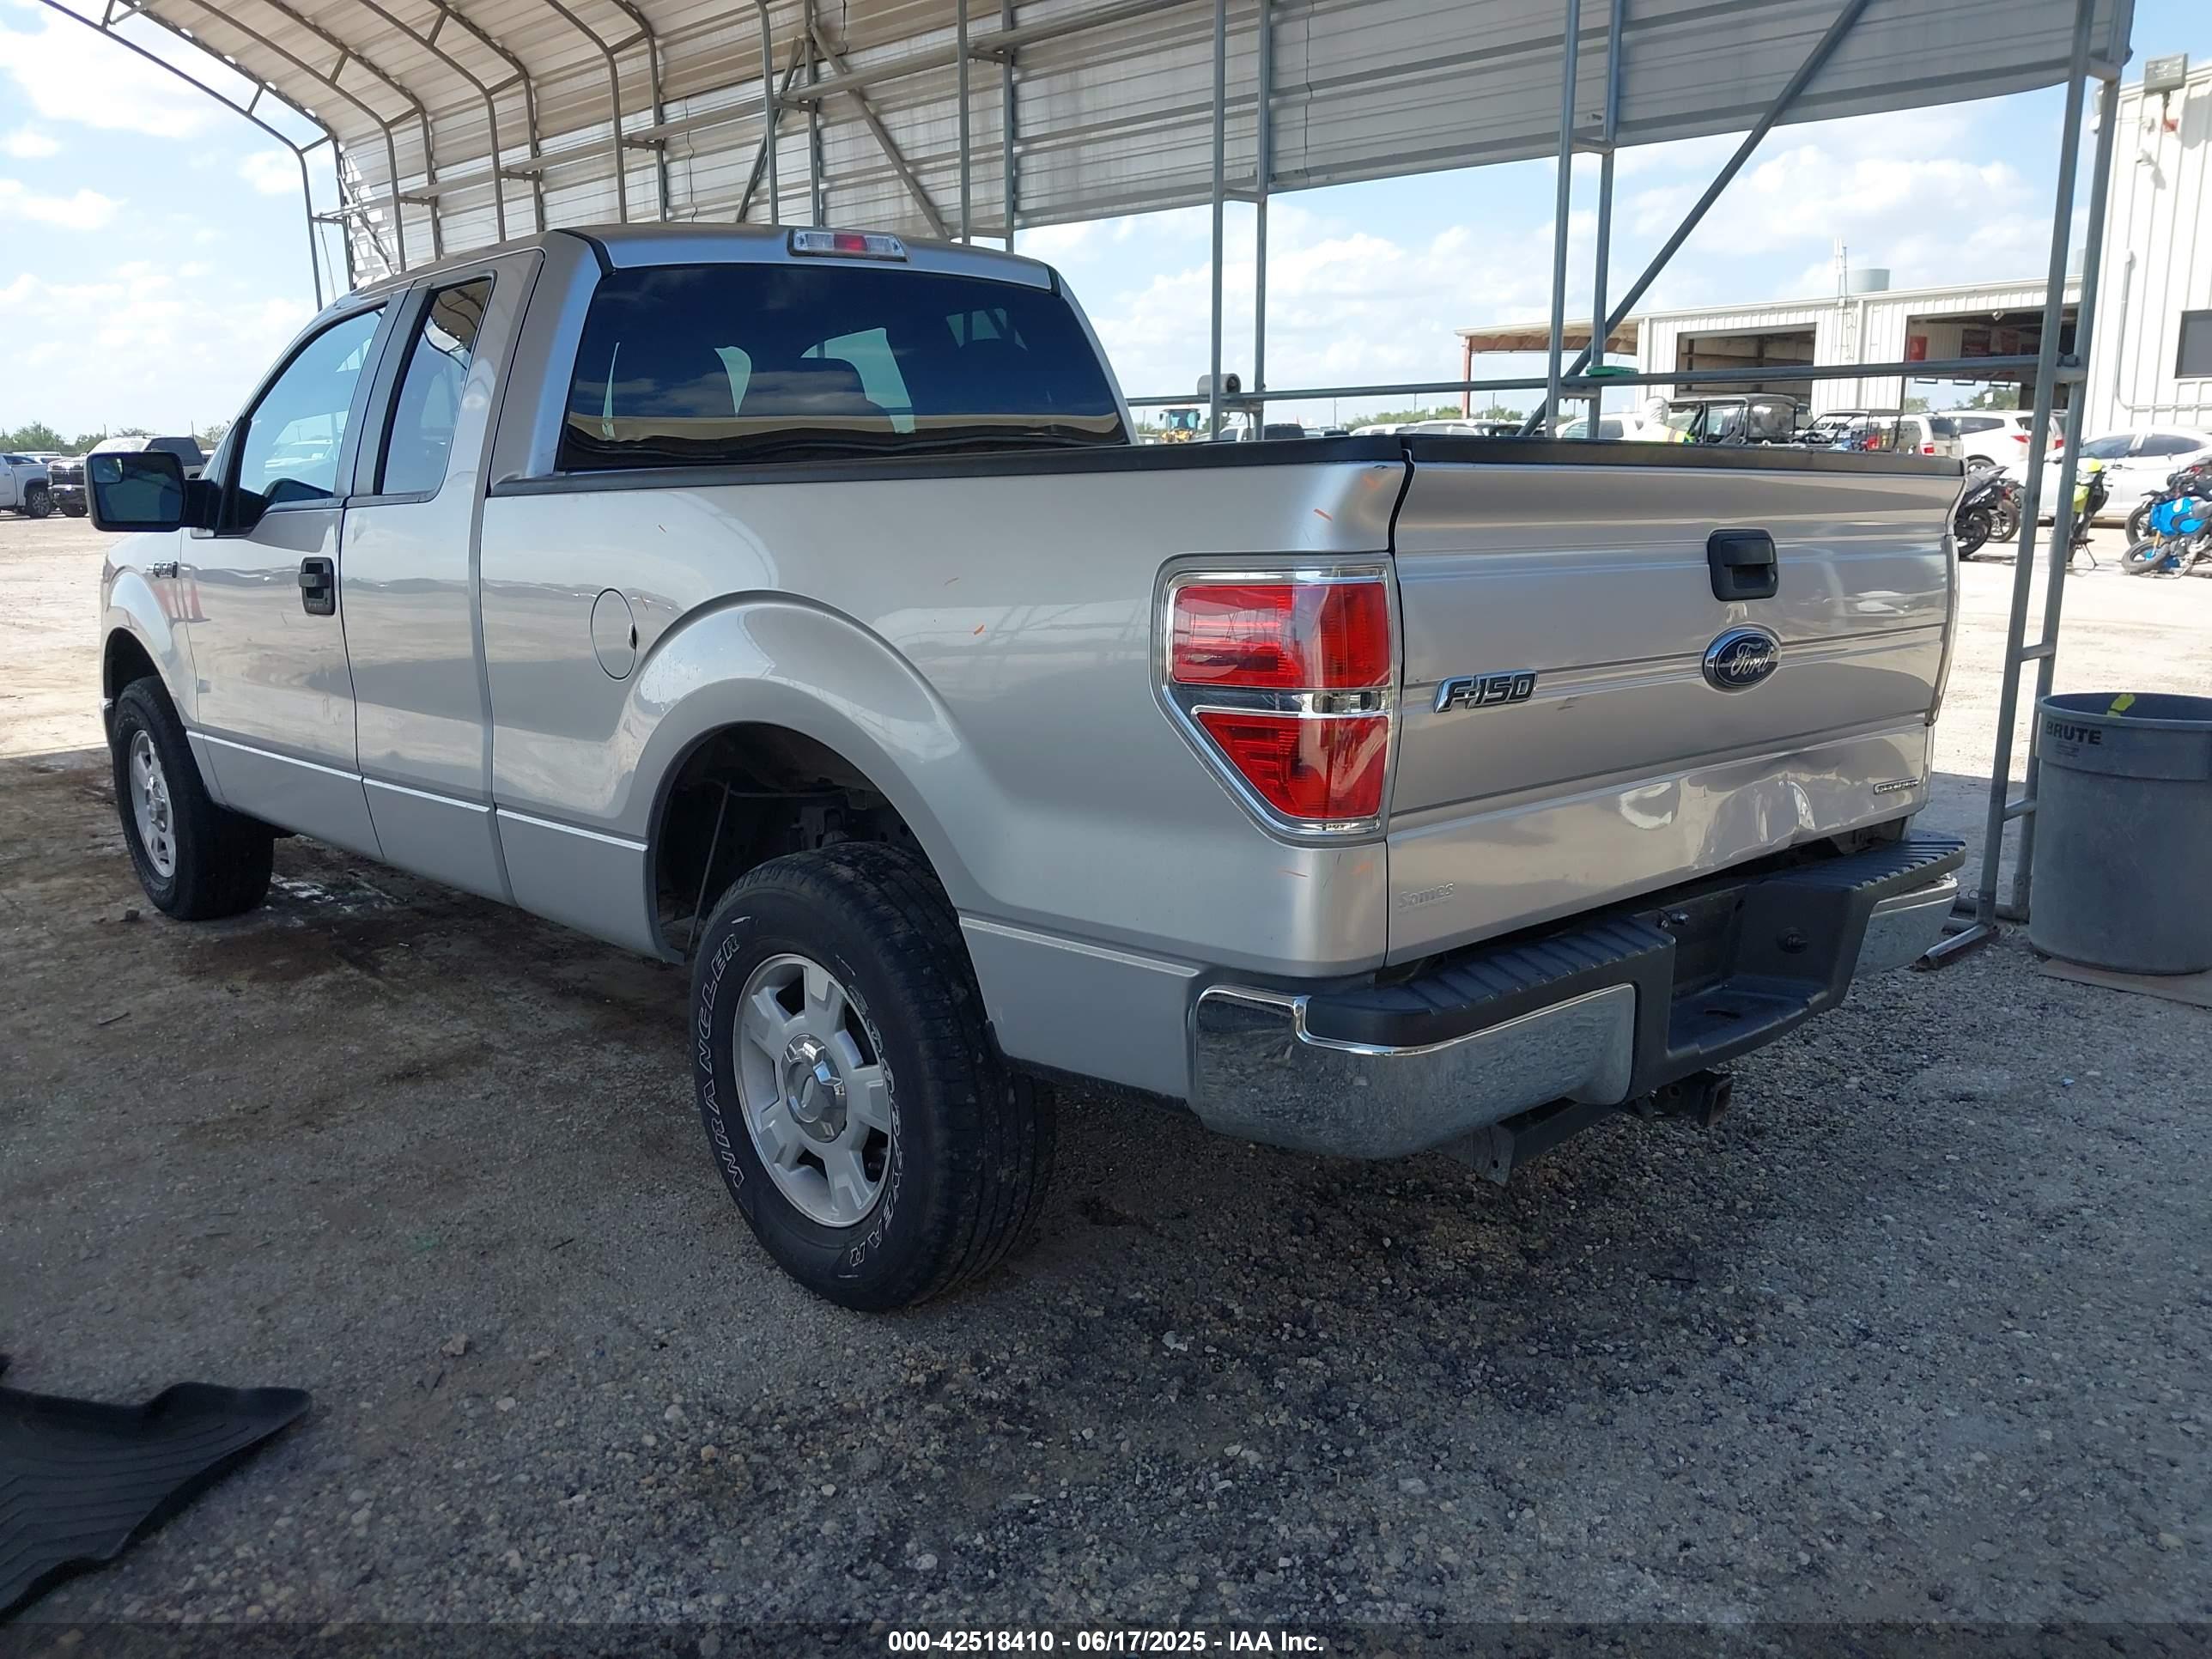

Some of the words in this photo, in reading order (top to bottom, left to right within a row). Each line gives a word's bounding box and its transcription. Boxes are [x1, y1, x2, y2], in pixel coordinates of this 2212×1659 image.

[1730, 642, 1774, 677] Ford
[1434, 669, 1538, 713] F-150
[2045, 720, 2103, 745] BRUTE
[697, 933, 744, 1189] WRANGLER
